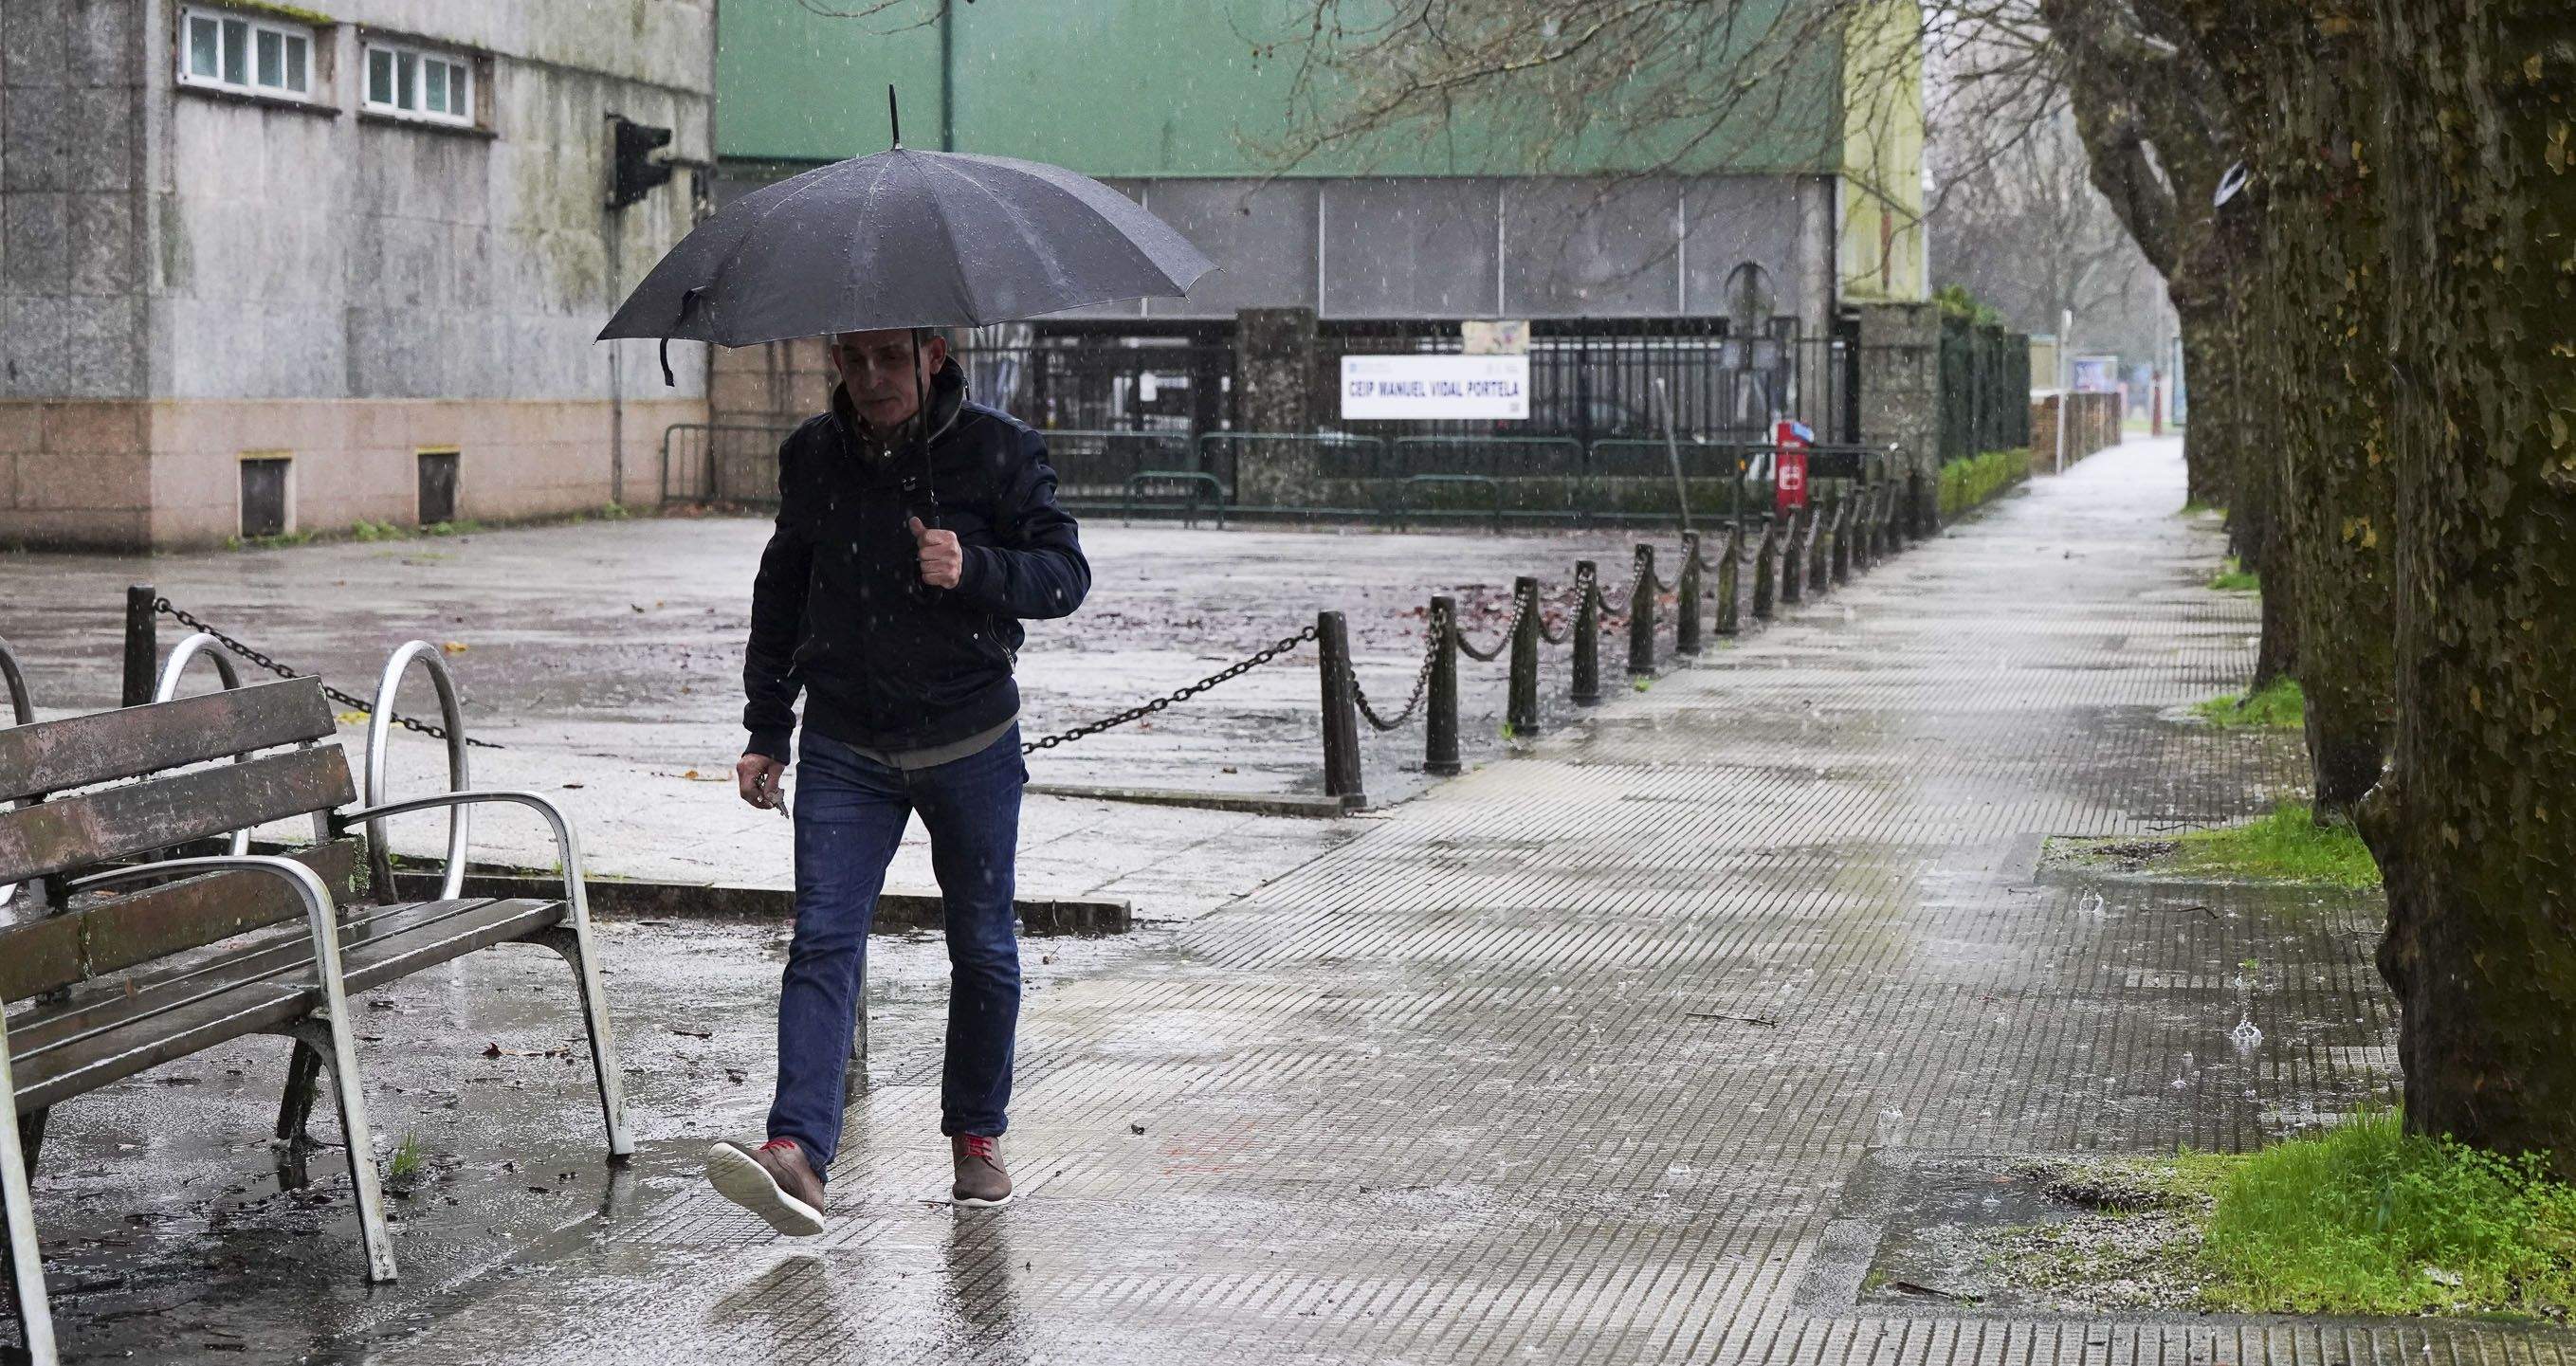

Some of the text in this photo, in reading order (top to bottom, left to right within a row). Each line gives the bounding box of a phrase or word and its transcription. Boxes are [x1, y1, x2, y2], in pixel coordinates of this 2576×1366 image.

[1349, 380, 1519, 397] CEIP MANUEL VIDAL PORTELA
